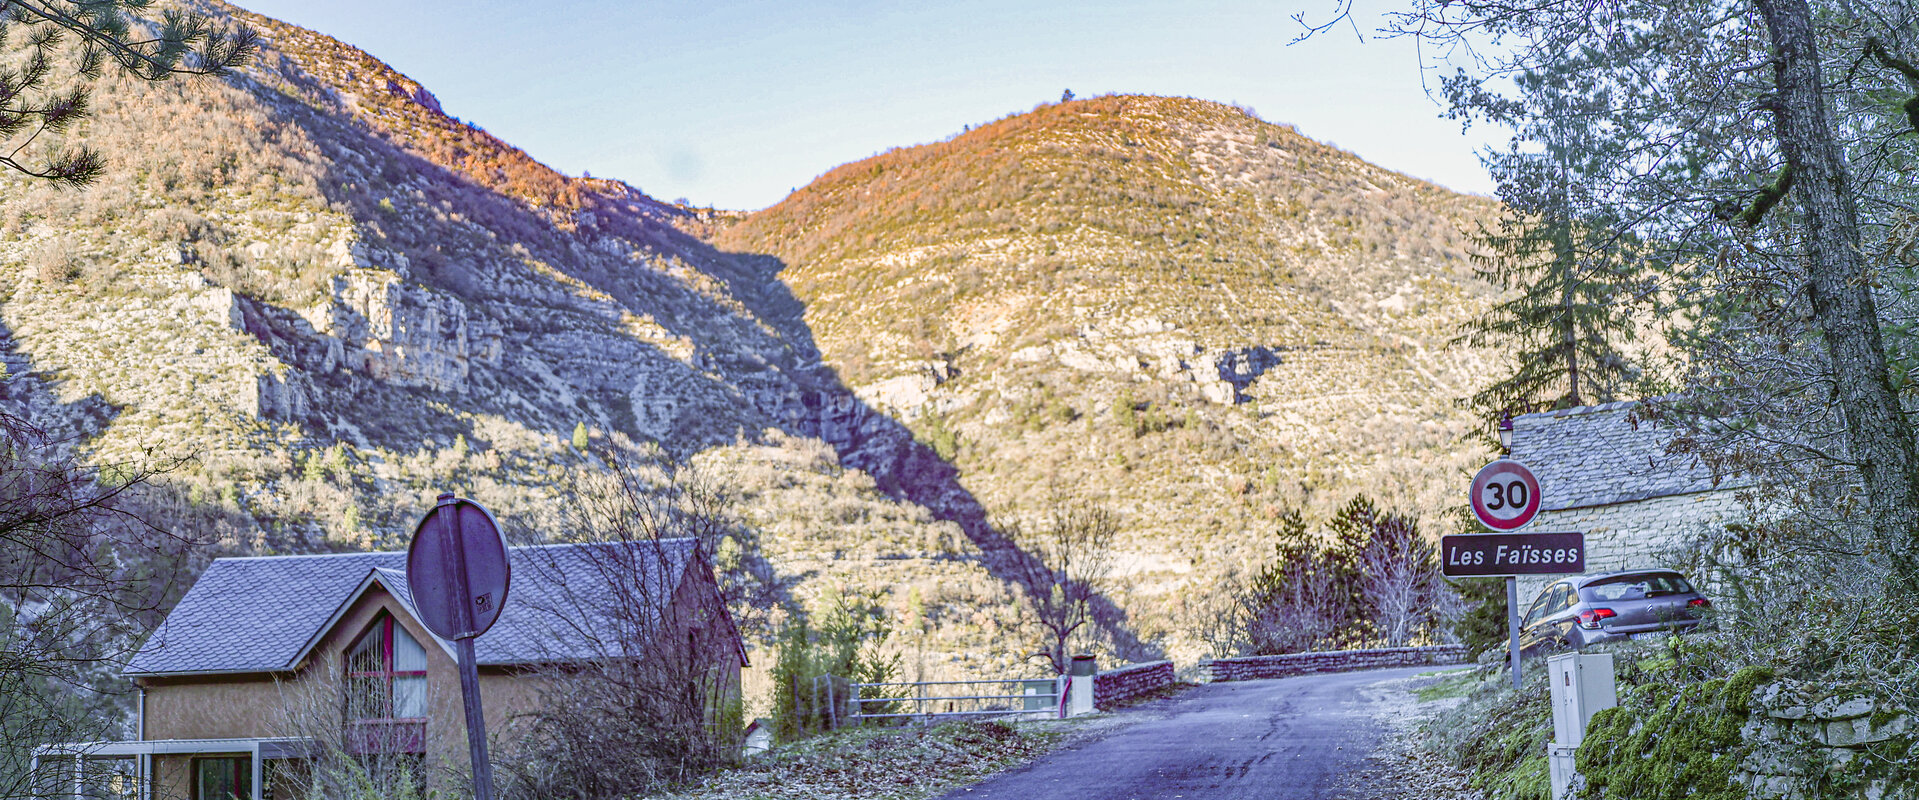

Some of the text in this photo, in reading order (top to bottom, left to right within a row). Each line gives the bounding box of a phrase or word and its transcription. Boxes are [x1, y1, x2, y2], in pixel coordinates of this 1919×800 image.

[1486, 481, 1527, 510] 30
[1450, 545, 1578, 566] Les Faïsses
